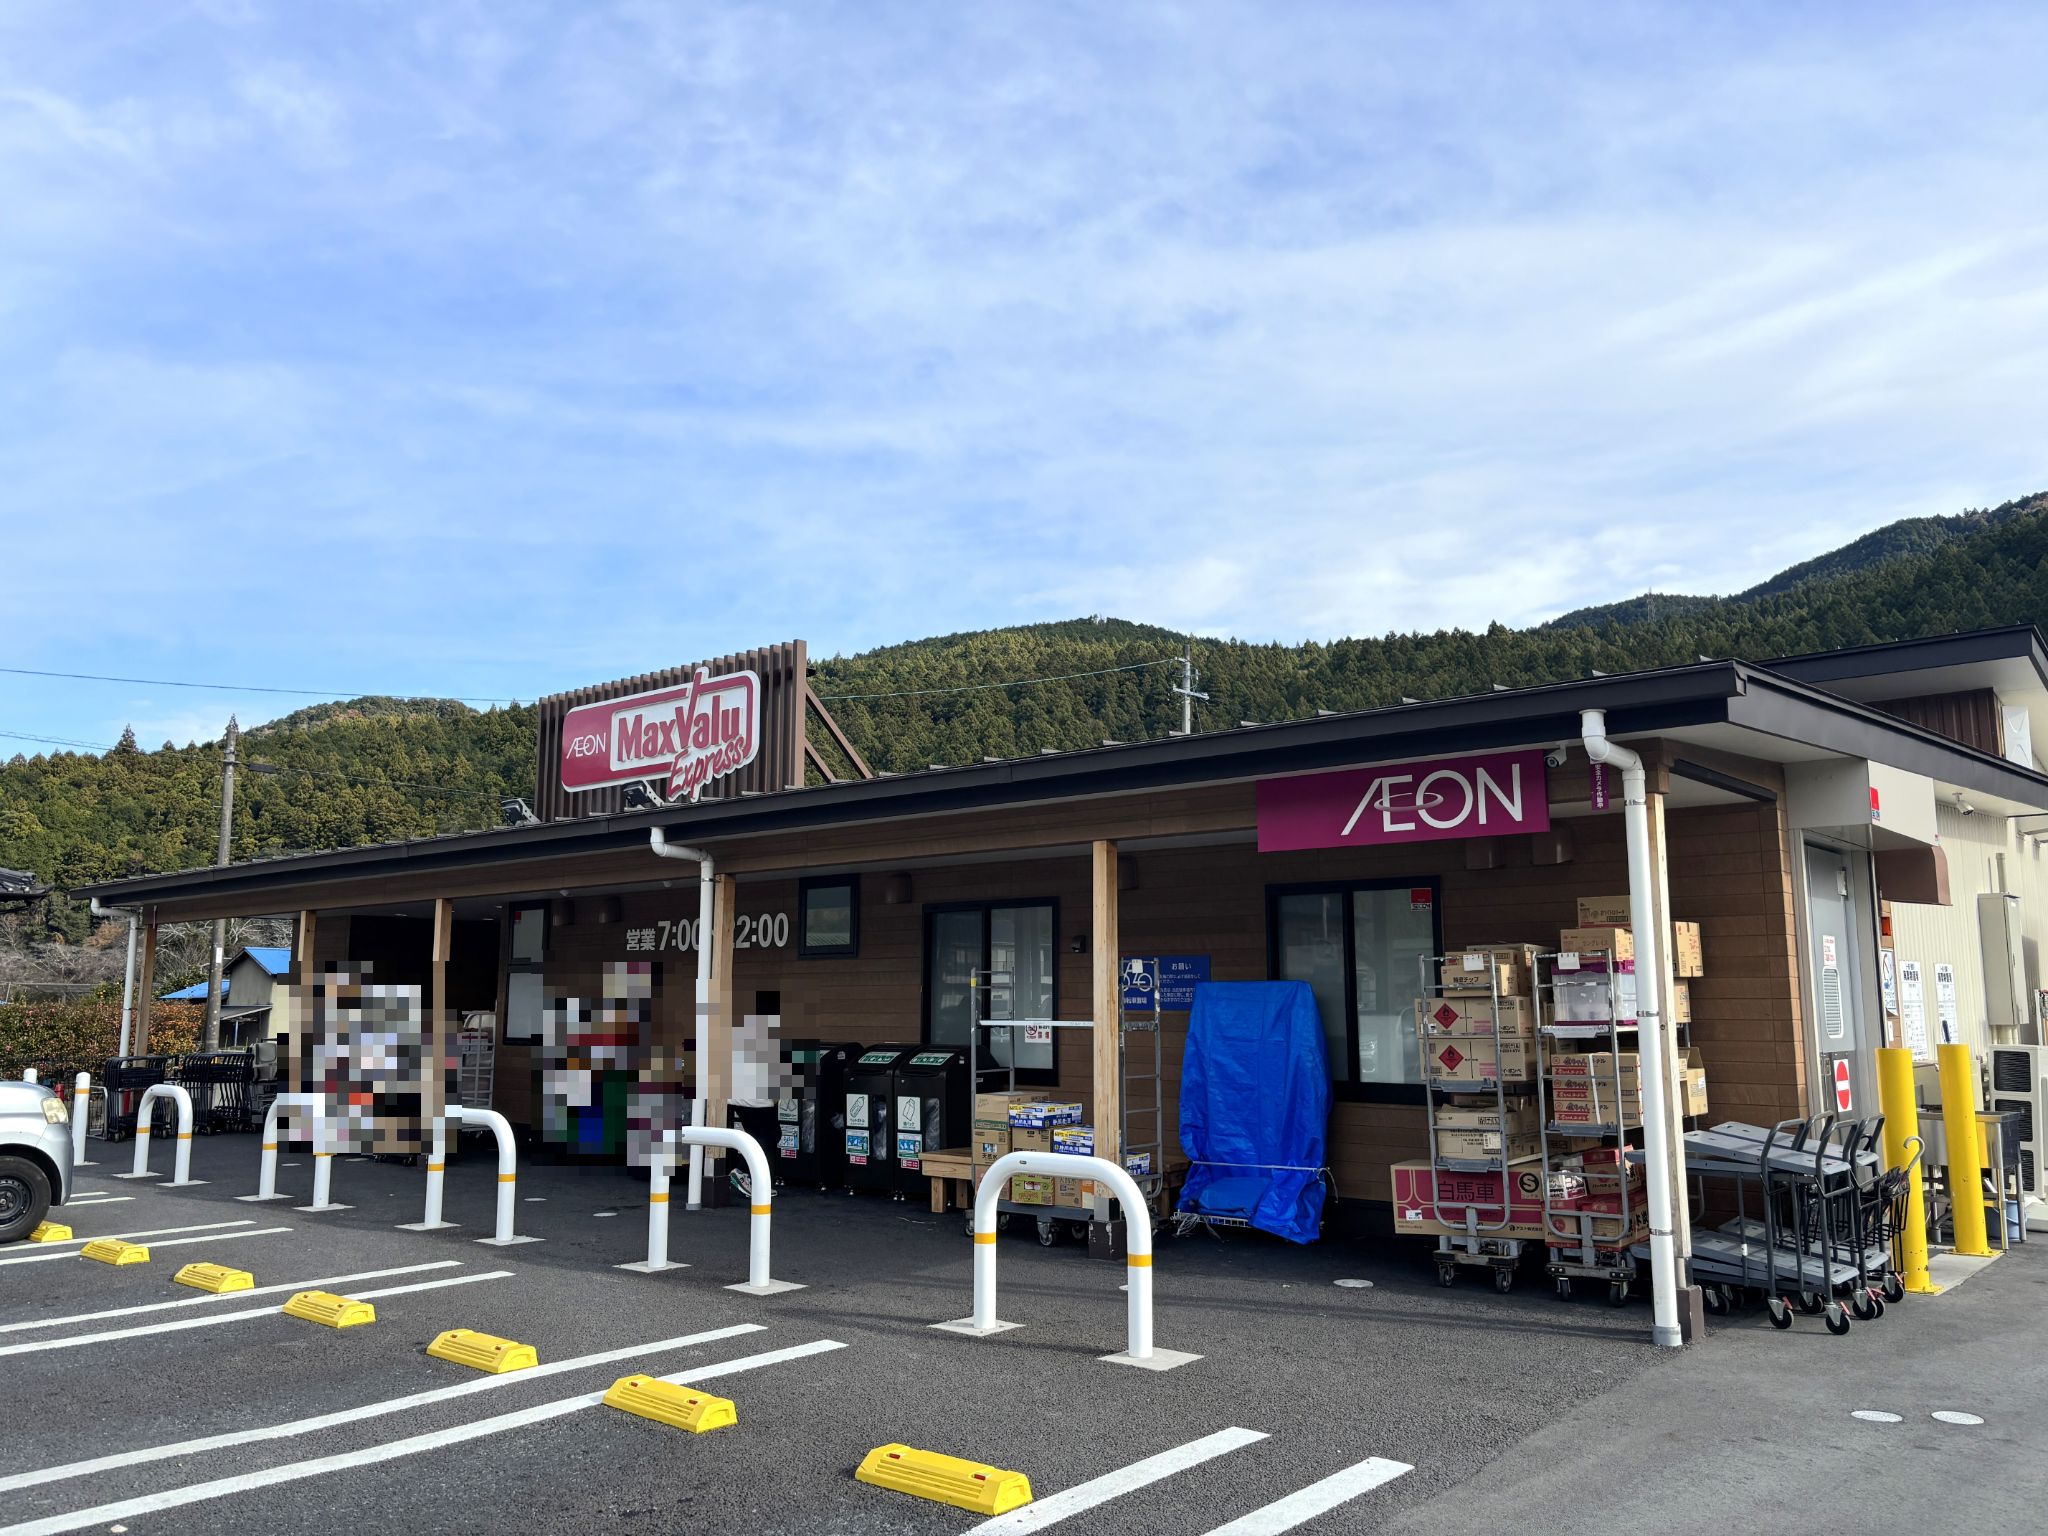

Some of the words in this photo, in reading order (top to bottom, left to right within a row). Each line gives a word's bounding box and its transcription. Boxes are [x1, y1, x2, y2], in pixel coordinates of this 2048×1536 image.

[617, 672, 741, 763] MaxValu
[667, 735, 745, 799] Express
[626, 928, 656, 951] 営業
[733, 912, 789, 949] 2:00
[1171, 962, 1192, 971] お願い
[1123, 996, 1148, 1004] 転車置場
[1438, 1181, 1495, 1202] 白馬車
